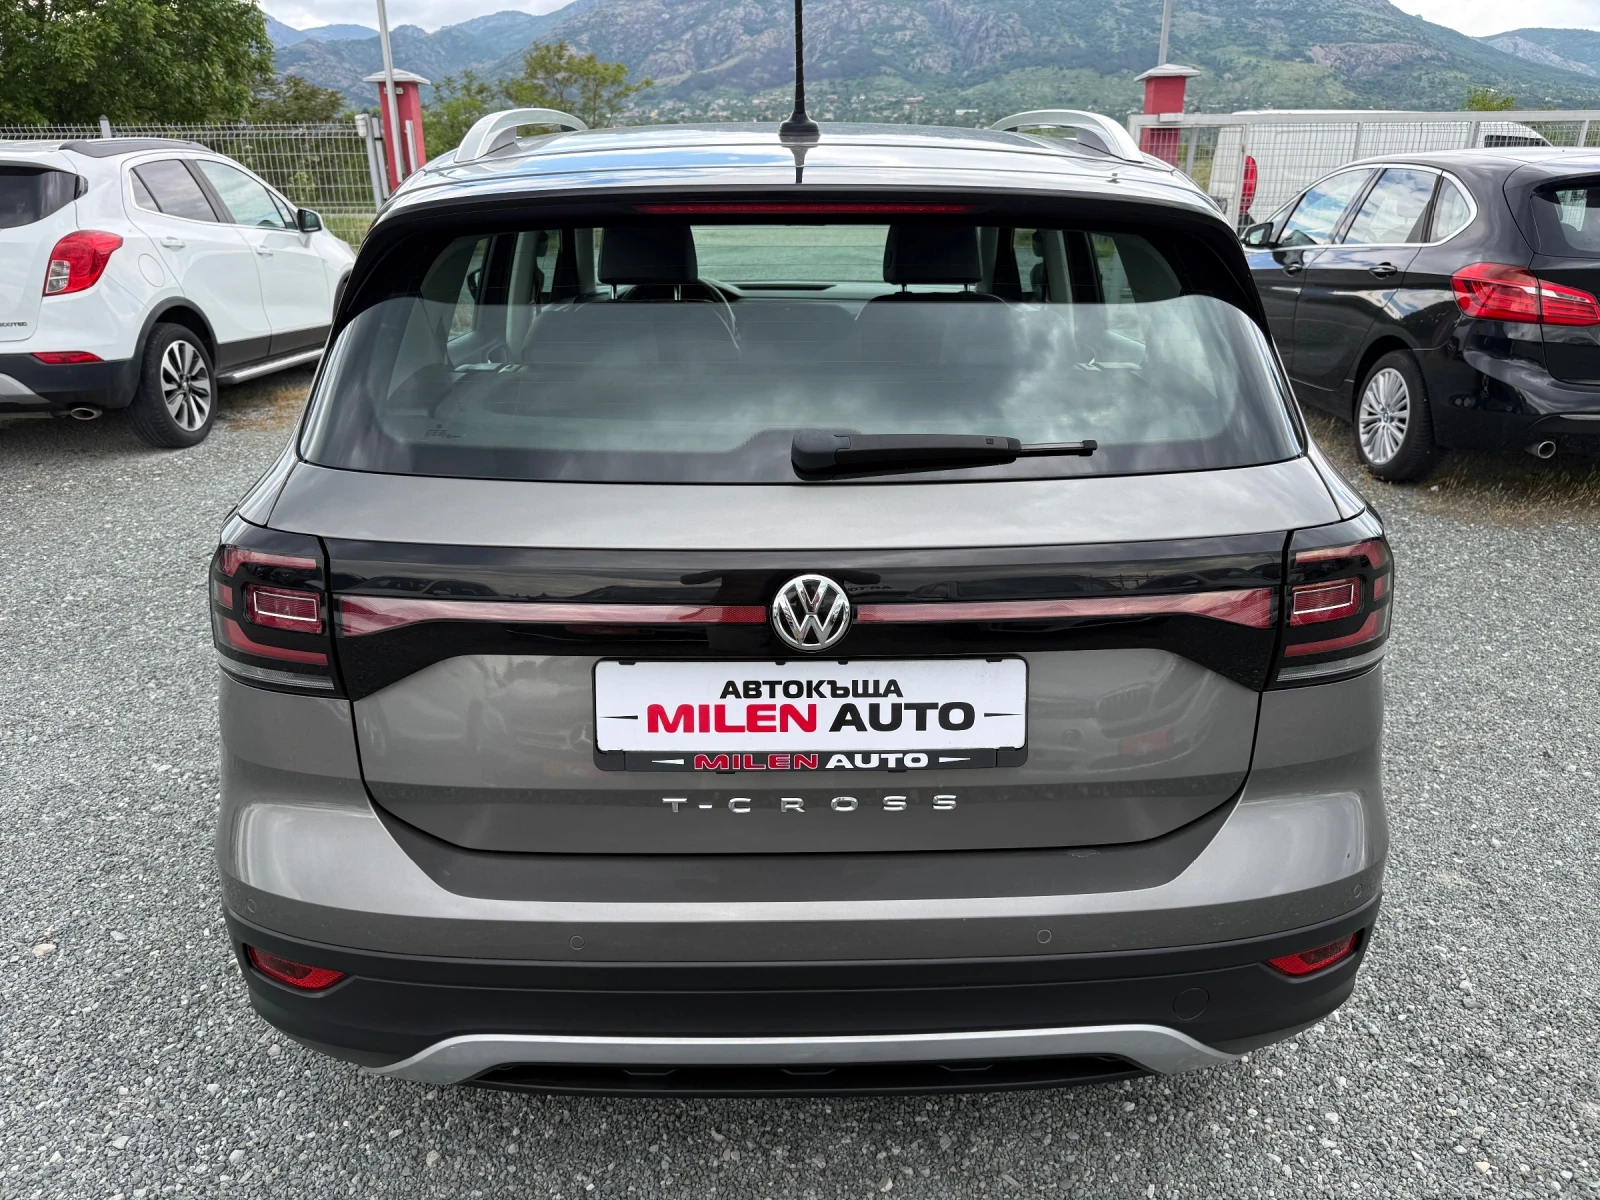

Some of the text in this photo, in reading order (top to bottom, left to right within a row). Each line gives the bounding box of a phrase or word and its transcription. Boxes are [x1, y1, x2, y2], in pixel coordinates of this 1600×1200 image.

[719, 678, 904, 700] АВТОКЪЩА
[647, 702, 976, 733] MILEN AUTO
[693, 752, 929, 770] MILEN AUTO
[662, 794, 957, 814] T-CROSS
